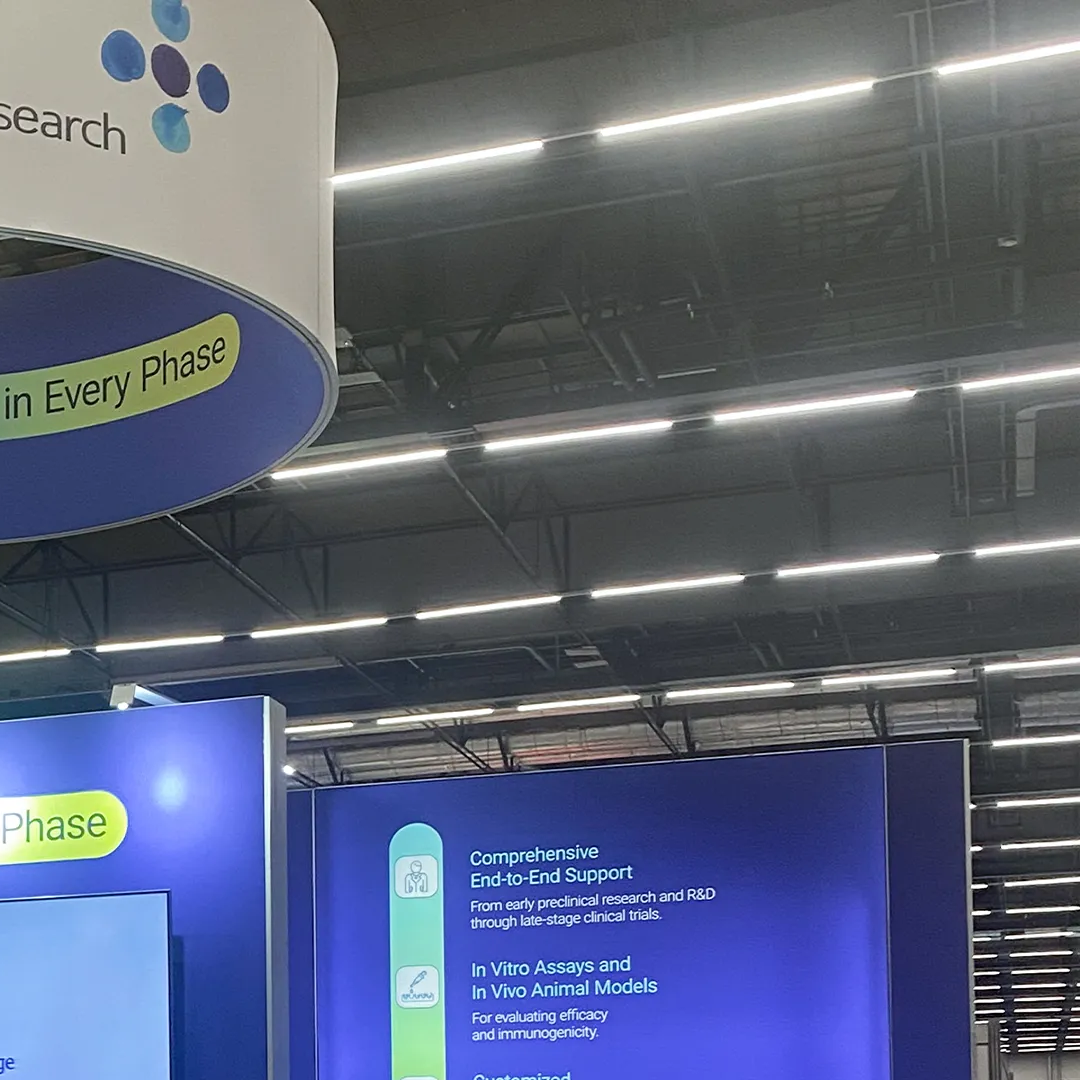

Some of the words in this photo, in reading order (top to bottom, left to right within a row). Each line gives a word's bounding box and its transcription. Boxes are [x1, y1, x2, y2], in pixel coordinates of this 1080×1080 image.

[5, 387, 32, 419] in
[45, 371, 132, 414] Every
[142, 336, 226, 391] Phase
[2, 809, 108, 844] Phase
[470, 844, 599, 867] Comprehensive
[471, 867, 560, 889] End-to-End
[565, 865, 633, 885] Support
[470, 900, 503, 913] From
[505, 897, 535, 912] early
[537, 893, 599, 911] preclinical
[602, 890, 656, 905] research
[659, 888, 684, 902] and
[687, 887, 716, 901] R&D
[470, 915, 517, 930] through
[520, 913, 581, 927] late-stage
[583, 909, 626, 923] clinical
[629, 907, 662, 921] trials.
[472, 963, 486, 977] In
[490, 961, 530, 977] Vitro
[534, 960, 595, 977] Assays
[599, 955, 631, 972] and
[472, 985, 487, 1000] In
[491, 983, 527, 999] Vivo
[531, 980, 589, 997] Animal
[594, 977, 658, 995] Models
[472, 1012, 492, 1024] For
[494, 1010, 556, 1024] evaluating
[559, 1008, 608, 1023] efficacy
[472, 1028, 495, 1041] and
[497, 1025, 599, 1041] immunogenicity.
